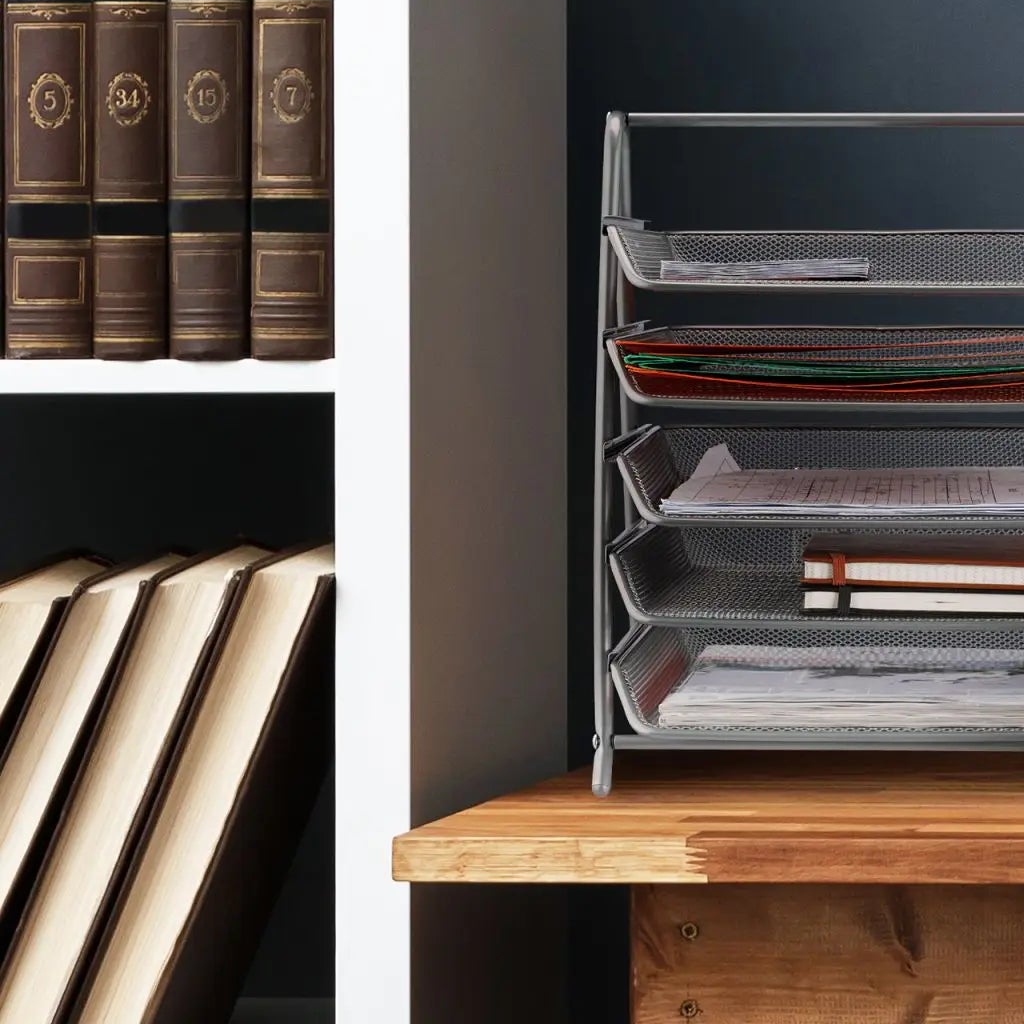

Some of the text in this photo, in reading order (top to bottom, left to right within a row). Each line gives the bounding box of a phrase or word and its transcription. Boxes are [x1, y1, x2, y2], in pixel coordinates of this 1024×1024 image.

[43, 90, 56, 111] 5
[115, 88, 141, 109] 34
[197, 88, 217, 107] 15
[285, 86, 298, 107] 7
